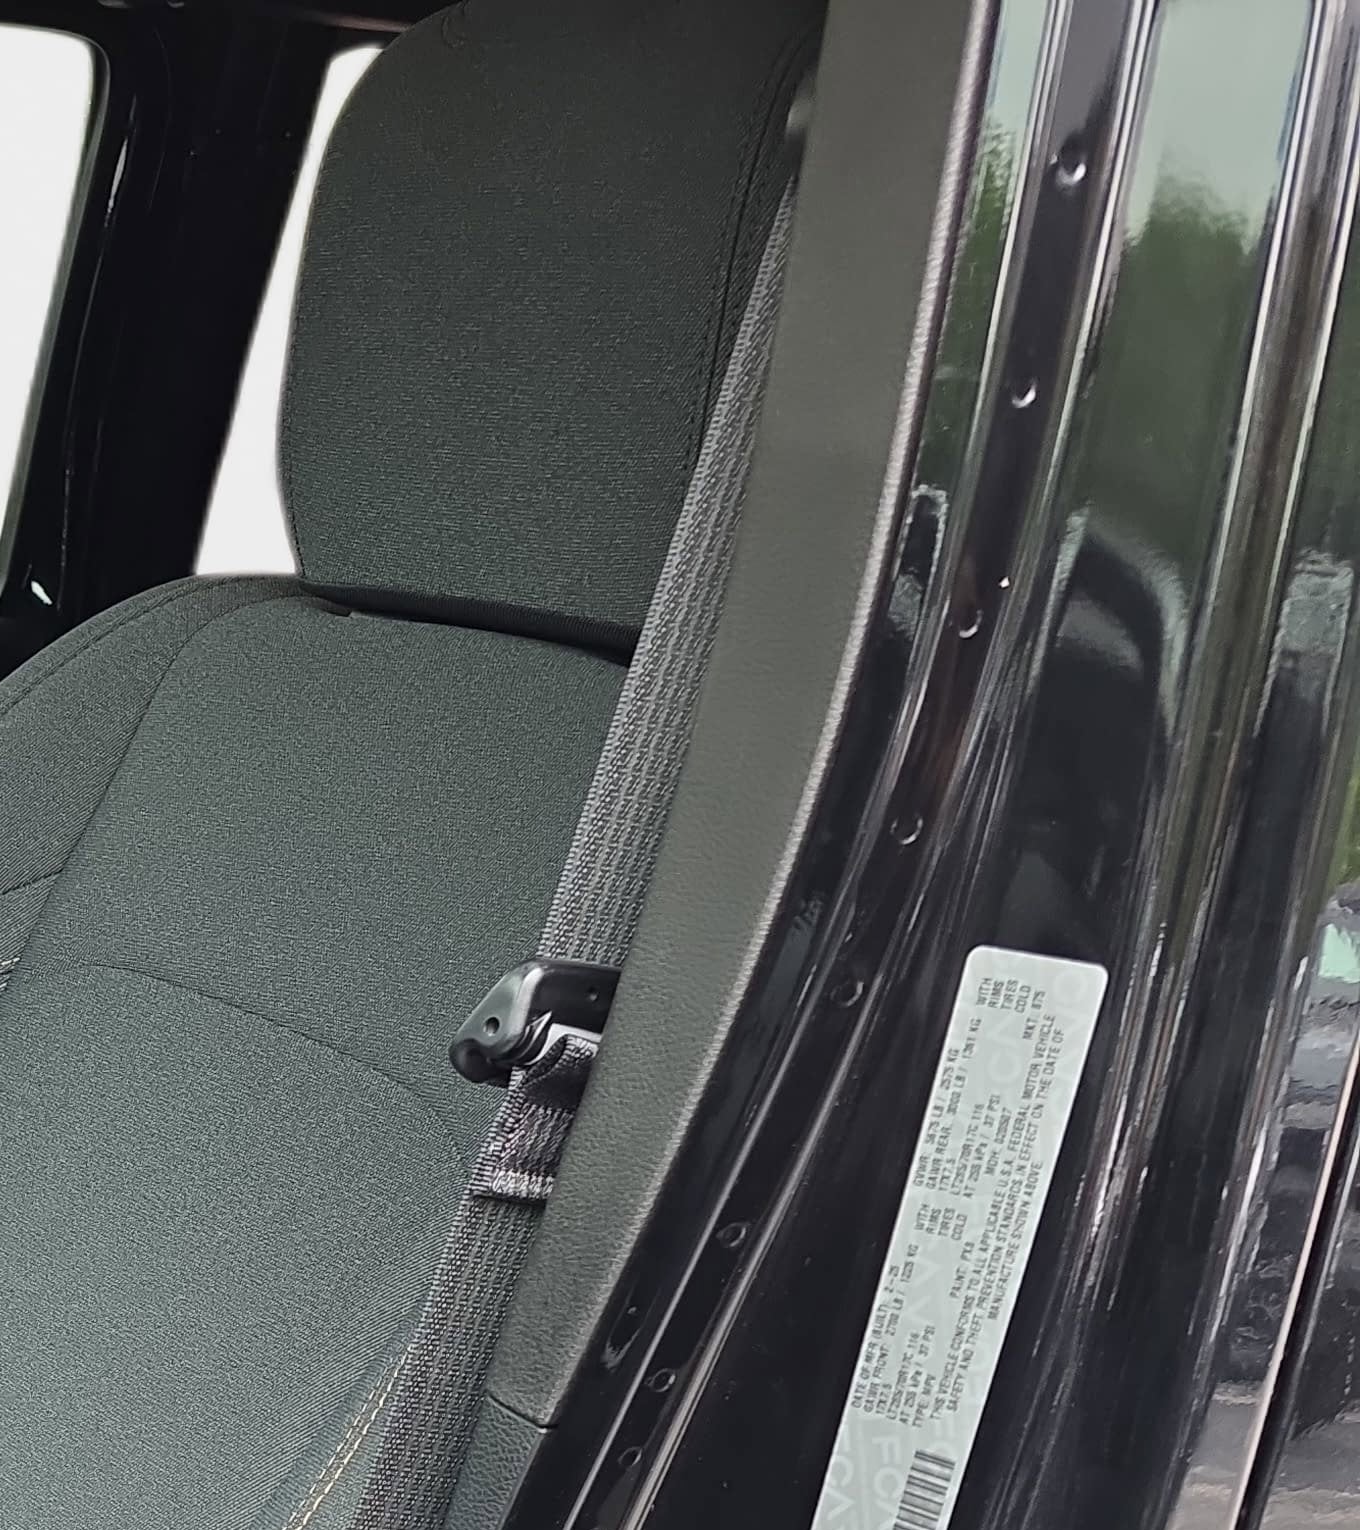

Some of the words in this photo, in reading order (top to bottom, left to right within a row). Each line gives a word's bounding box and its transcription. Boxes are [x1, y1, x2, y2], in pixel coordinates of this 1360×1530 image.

[974, 975, 993, 1007] WITH
[986, 979, 1005, 1009] RIMS
[999, 977, 1019, 1011] TIRES
[1012, 983, 1032, 1014] COLD
[1032, 1013, 1057, 1060] VEHICLE
[1020, 1061, 1043, 1101] MOTOR
[1005, 1102, 1031, 1153] FEDERAL
[924, 1155, 943, 1190] GAWR
[913, 1201, 931, 1232] WITH
[924, 1206, 942, 1235] RIMS
[936, 1205, 956, 1238] TIRES
[945, 1371, 967, 1413] SAFETY
[964, 1311, 985, 1347] THEFT
[975, 1244, 1005, 1311] PREVENTION
[993, 1177, 1024, 1244] STANDARDS
[1017, 1121, 1040, 1162] EFFECT
[1041, 1045, 1061, 1076] DATE
[949, 1211, 968, 1242] COLD
[977, 1189, 1006, 1253] APPLICABLE
[986, 1240, 1020, 1321] MANUFACTURE
[949, 1293, 976, 1352] CONFORMS
[936, 1351, 959, 1395] VEHICLE
[850, 1381, 867, 1409] DATE
[862, 1380, 881, 1414] GAWR
[929, 1396, 946, 1422] THIS
